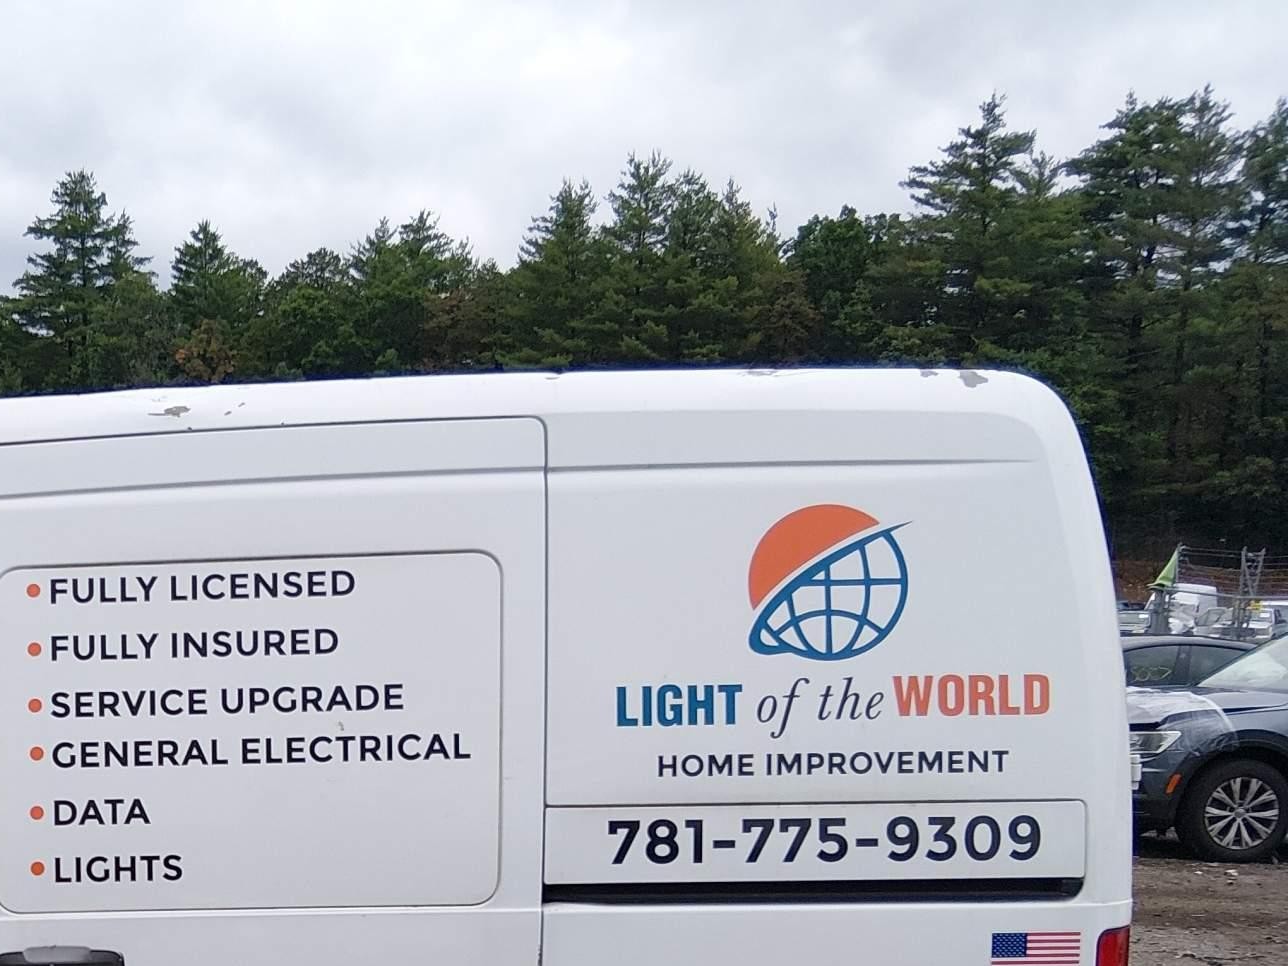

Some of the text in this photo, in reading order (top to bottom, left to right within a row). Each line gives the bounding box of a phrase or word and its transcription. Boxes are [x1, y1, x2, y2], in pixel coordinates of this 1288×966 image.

[50, 570, 357, 605] FULLY LICENSED
[50, 628, 339, 662] FULLY INSURED
[50, 683, 404, 719] SERVICE UPGRADE
[616, 674, 1050, 740] LIGHT of the WORLD
[51, 733, 472, 769] GENERAL ELECTRICAL
[657, 750, 1010, 778] HOME IMPROVEMENT
[53, 798, 152, 827] DATA
[607, 814, 1042, 865] 781-775-9309
[54, 854, 183, 884] LIGHTS
